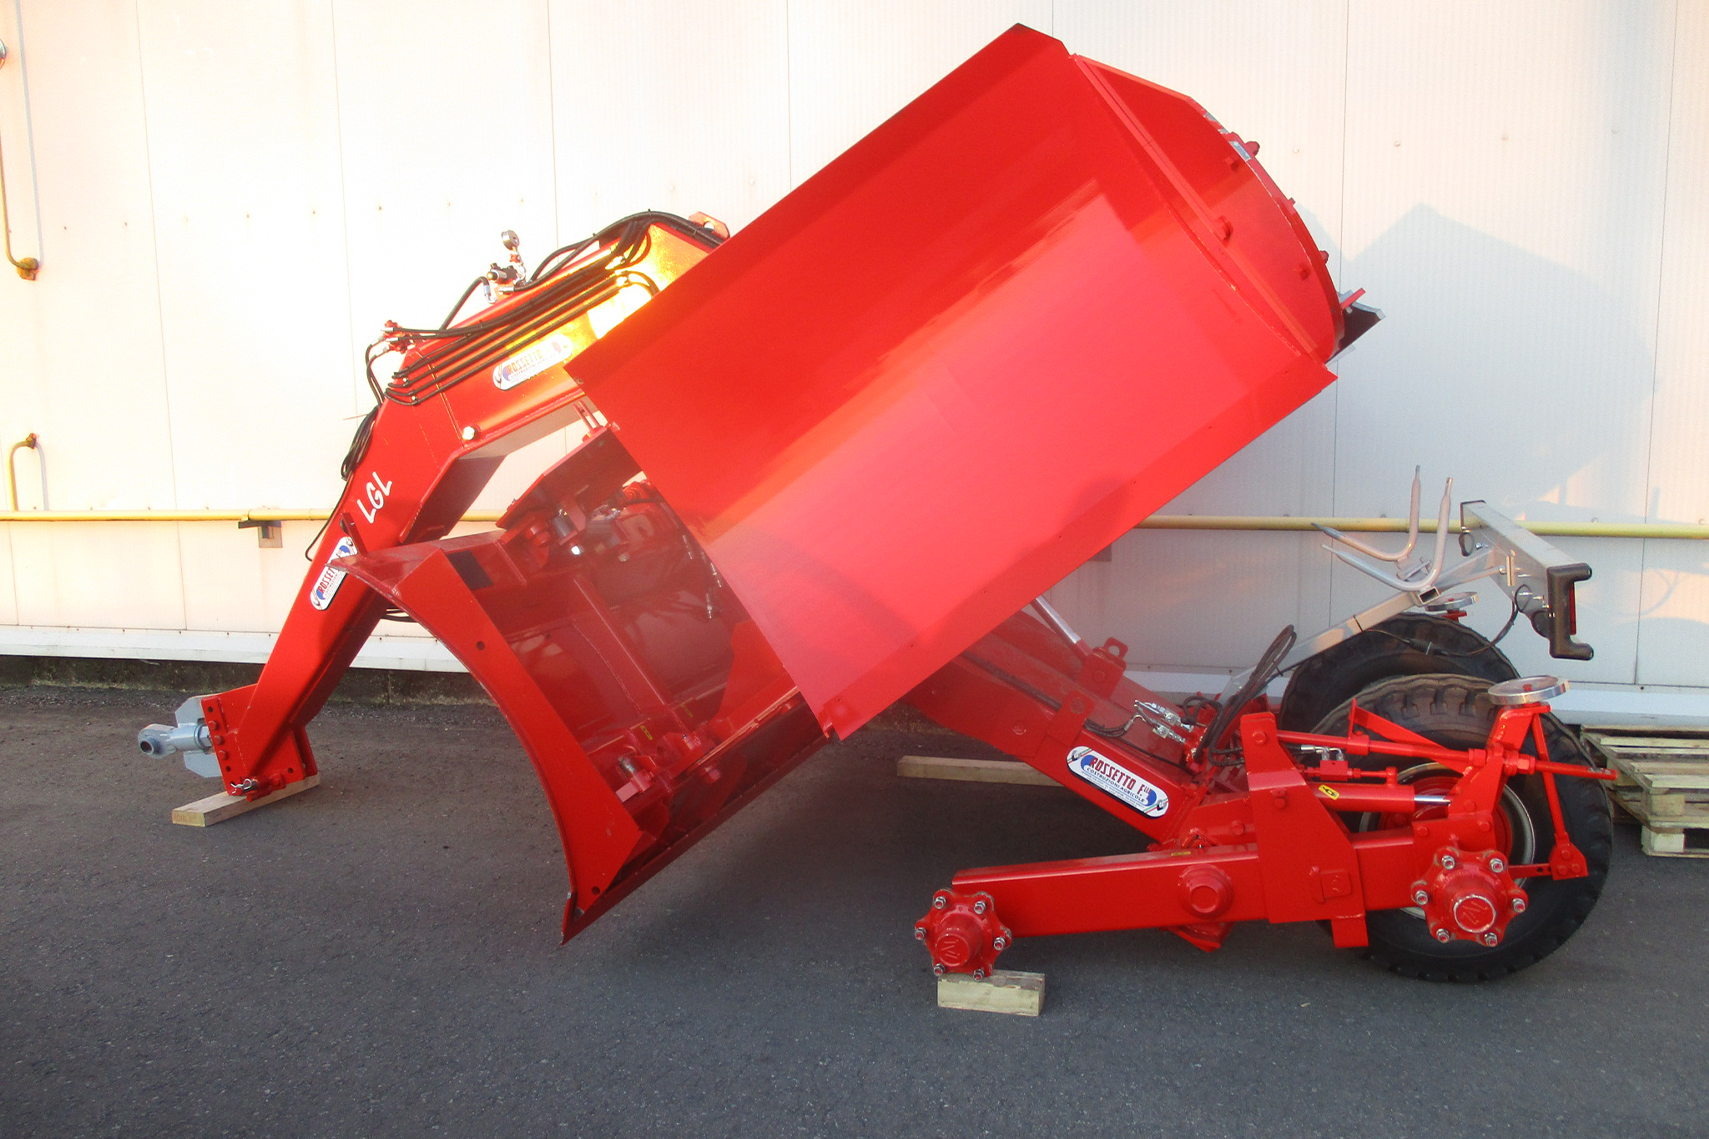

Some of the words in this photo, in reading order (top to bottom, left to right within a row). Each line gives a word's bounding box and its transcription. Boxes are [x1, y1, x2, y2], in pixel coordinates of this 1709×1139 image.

[357, 471, 393, 524] LGL
[318, 566, 336, 594] ROSSET
[1086, 767, 1120, 790] COSTRUZIONI
[1120, 787, 1145, 803] AGRICOLE
[1089, 756, 1137, 791] ROSSETTO
